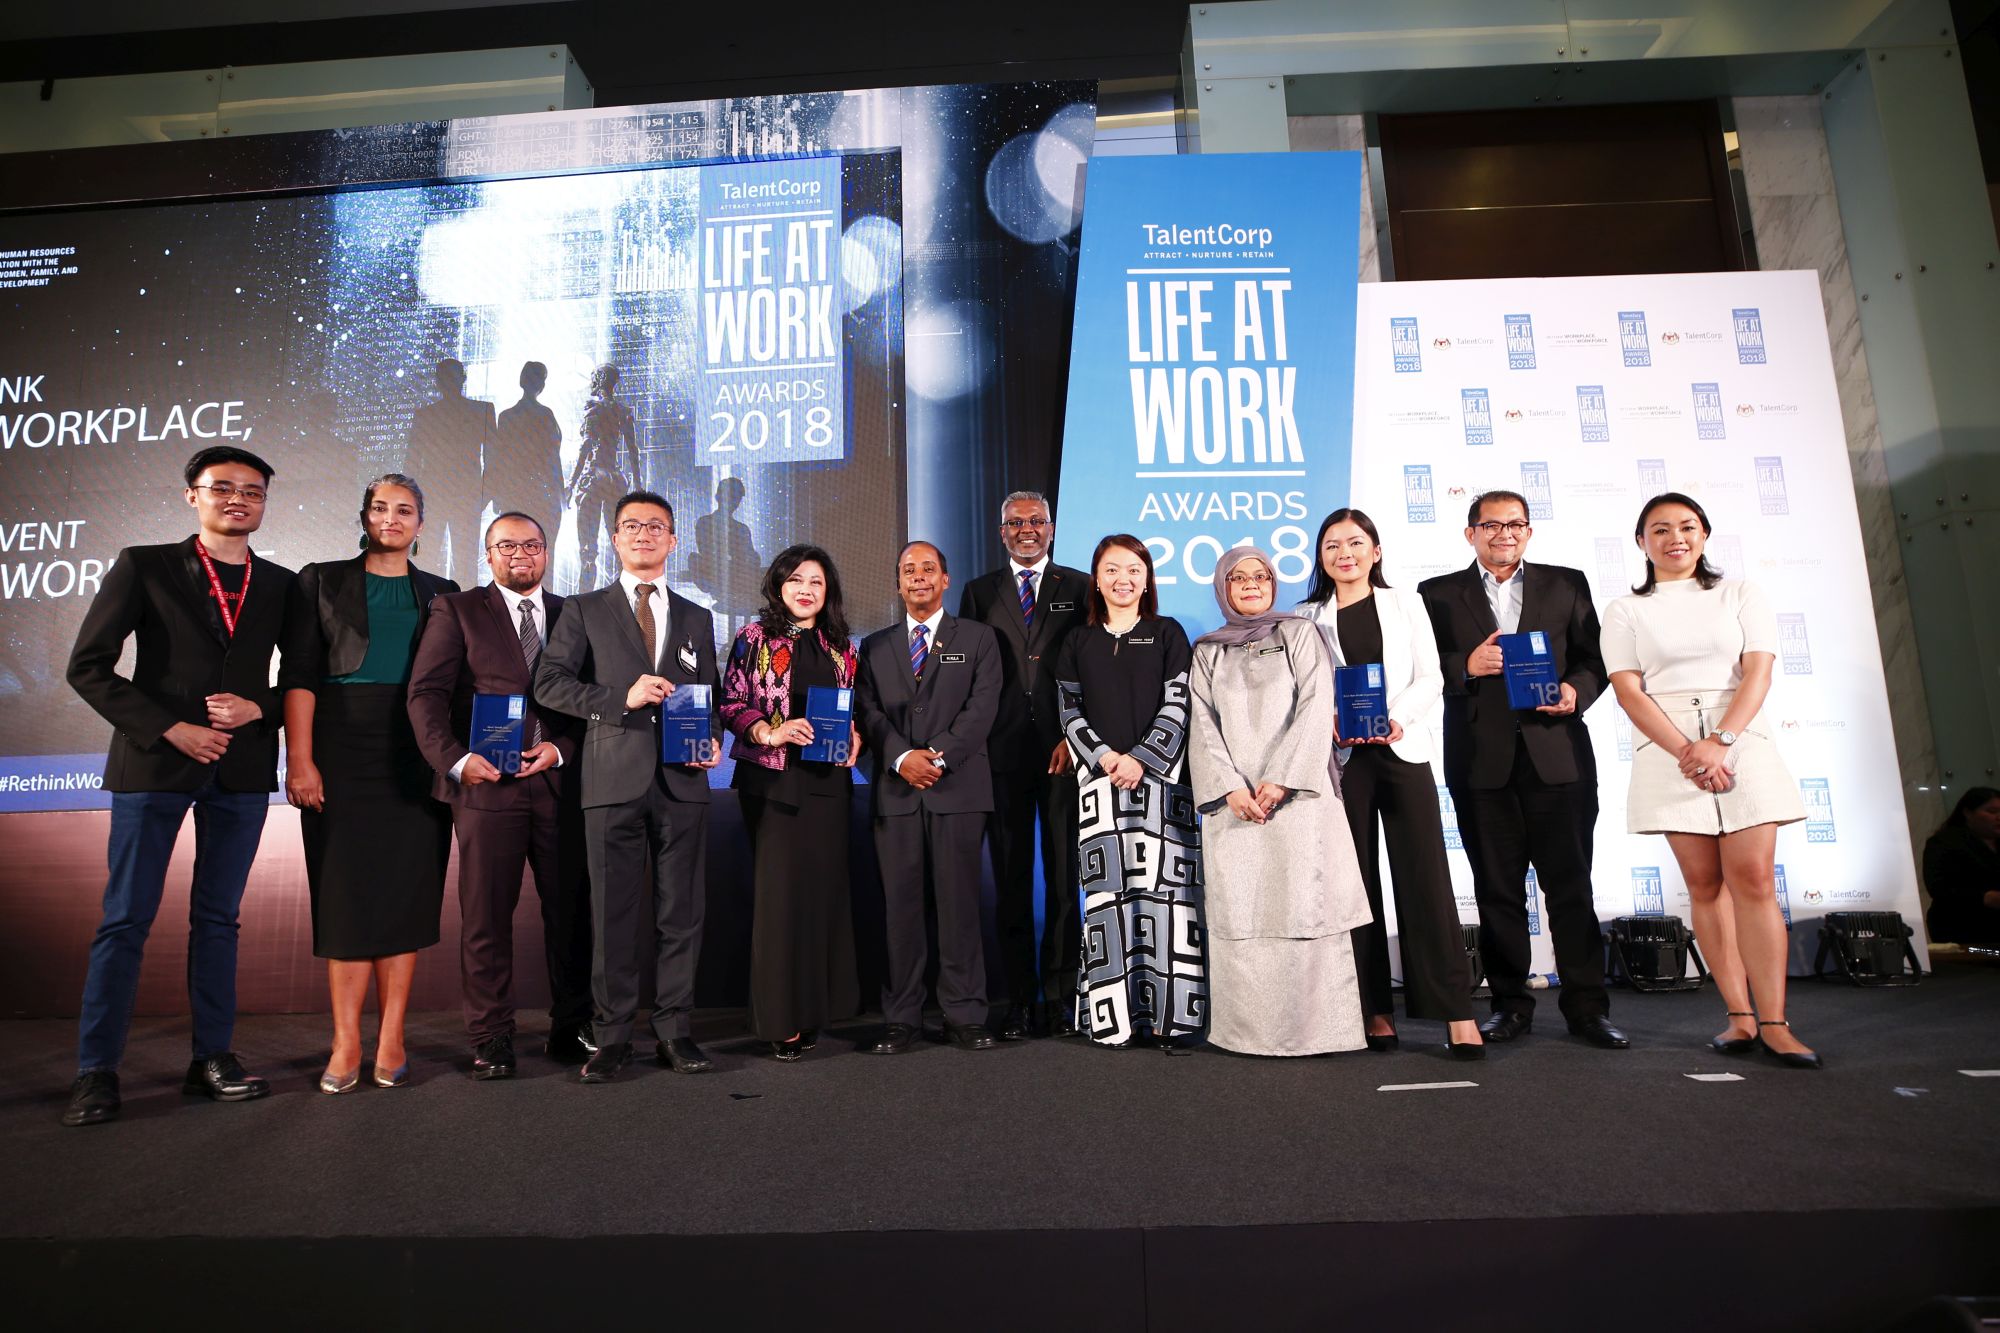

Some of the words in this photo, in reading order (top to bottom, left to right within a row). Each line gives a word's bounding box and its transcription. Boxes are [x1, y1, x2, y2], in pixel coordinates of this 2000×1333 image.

[680, 116, 699, 125] 415
[720, 179, 821, 200] TalentCorp
[1142, 223, 1273, 249] TalentCorp
[0, 250, 27, 259] HUMAN
[30, 247, 75, 257] RESOURCES
[705, 223, 772, 288] LIFE
[785, 220, 833, 283] AT
[22, 259, 42, 267] WITH
[44, 258, 59, 266] THE
[31, 268, 60, 276] FAMILY,
[61, 266, 78, 274] AND
[705, 285, 835, 365] WORK
[1126, 281, 1217, 362] LIFE
[1234, 279, 1291, 361] AT
[1621, 321, 1635, 335] LIFE
[1634, 320, 1645, 334] AT
[1735, 319, 1749, 332] LIFE
[1749, 318, 1760, 331] AT
[1394, 327, 1406, 340] LIFE
[1407, 326, 1417, 339] AT
[1507, 324, 1520, 338] LIFE
[1520, 323, 1531, 337] AT
[1685, 332, 1723, 340] TalentCorp
[1508, 337, 1533, 352] WORK
[1622, 334, 1647, 350] WORK
[1737, 332, 1762, 347] WORK
[1394, 340, 1418, 355] WORK
[1510, 357, 1535, 367] 2018
[1625, 355, 1650, 365] 2018
[1740, 352, 1765, 362] 2018
[1396, 360, 1420, 370] 2018
[715, 379, 825, 405] AWARDS
[1695, 393, 1709, 407] LIFE
[1709, 392, 1720, 406] AT
[1464, 398, 1477, 412] LIFE
[1478, 397, 1488, 411] AT
[1579, 396, 1593, 410] LIFE
[1593, 395, 1604, 409] AT
[1129, 366, 1305, 465] WORK
[1465, 412, 1490, 428] WORK
[1581, 409, 1606, 425] WORK
[1696, 407, 1722, 422] WORK
[0, 401, 252, 449] WORKPLACE,
[709, 406, 833, 452] 2018
[1467, 432, 1492, 443] 2018
[1583, 430, 1608, 440] 2018
[1699, 428, 1725, 438] 2018
[1523, 472, 1537, 486] LIFE
[1537, 471, 1548, 485] AT
[1757, 467, 1772, 481] LIFE
[1771, 466, 1783, 480] AT
[1406, 475, 1420, 489] LIFE
[1420, 474, 1431, 488] AT
[1759, 481, 1785, 497] WORK
[1407, 489, 1432, 505] WORK
[1524, 486, 1550, 502] WORK
[1138, 491, 1307, 522] AWARDS
[1762, 502, 1788, 513] 2018
[1408, 510, 1434, 521] 2018
[1145, 525, 1313, 585] 208
[1780, 624, 1794, 639] LIFE
[1794, 623, 1806, 638] AT
[1782, 638, 1808, 655] WORK
[1784, 661, 1811, 672] 2018
[1530, 682, 1560, 705] '18
[1359, 715, 1390, 737] '18
[1817, 789, 1829, 804] AT
[1808, 829, 1834, 840] 2018
[1634, 878, 1648, 894] LIFE
[1649, 877, 1660, 893] AT
[1829, 889, 1870, 899] TalentCorp
[1635, 893, 1662, 911] WORK
